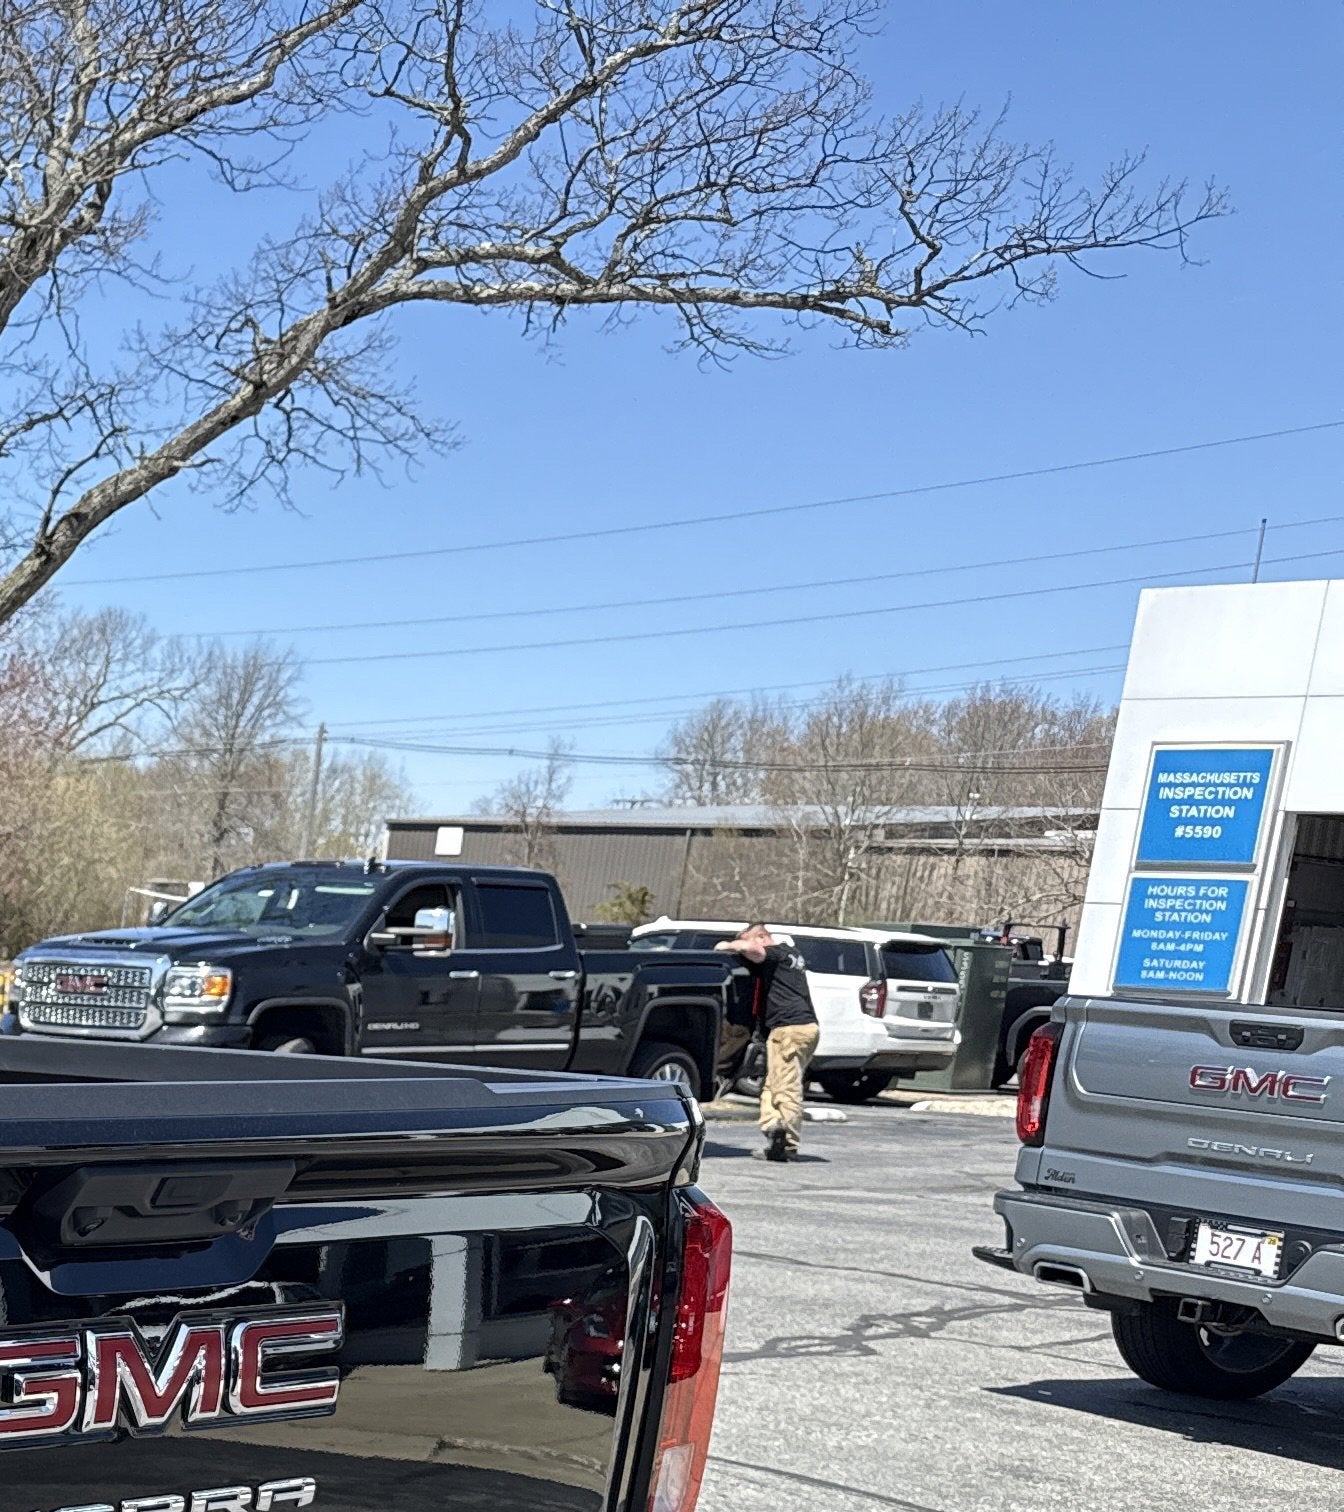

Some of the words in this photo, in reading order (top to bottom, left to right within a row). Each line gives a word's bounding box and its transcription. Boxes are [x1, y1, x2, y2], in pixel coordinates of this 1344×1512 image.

[1157, 771, 1261, 784] MASSACHUSETTS
[1158, 786, 1254, 800] INSPECTION
[1169, 805, 1236, 818] STATION
[1174, 825, 1222, 838] #5590
[1147, 885, 1196, 897] HOURS
[1199, 886, 1229, 898] FOR
[1144, 898, 1227, 911] INSPECTION
[1154, 911, 1212, 923] STATION
[1132, 929, 1229, 941] MONDAY-FRIDAY
[1143, 958, 1206, 969] SATURDAY
[1188, 1064, 1333, 1104] GMC
[1187, 1137, 1314, 1164] DENALI
[1209, 1232, 1246, 1261] 527
[1251, 1241, 1262, 1265] A
